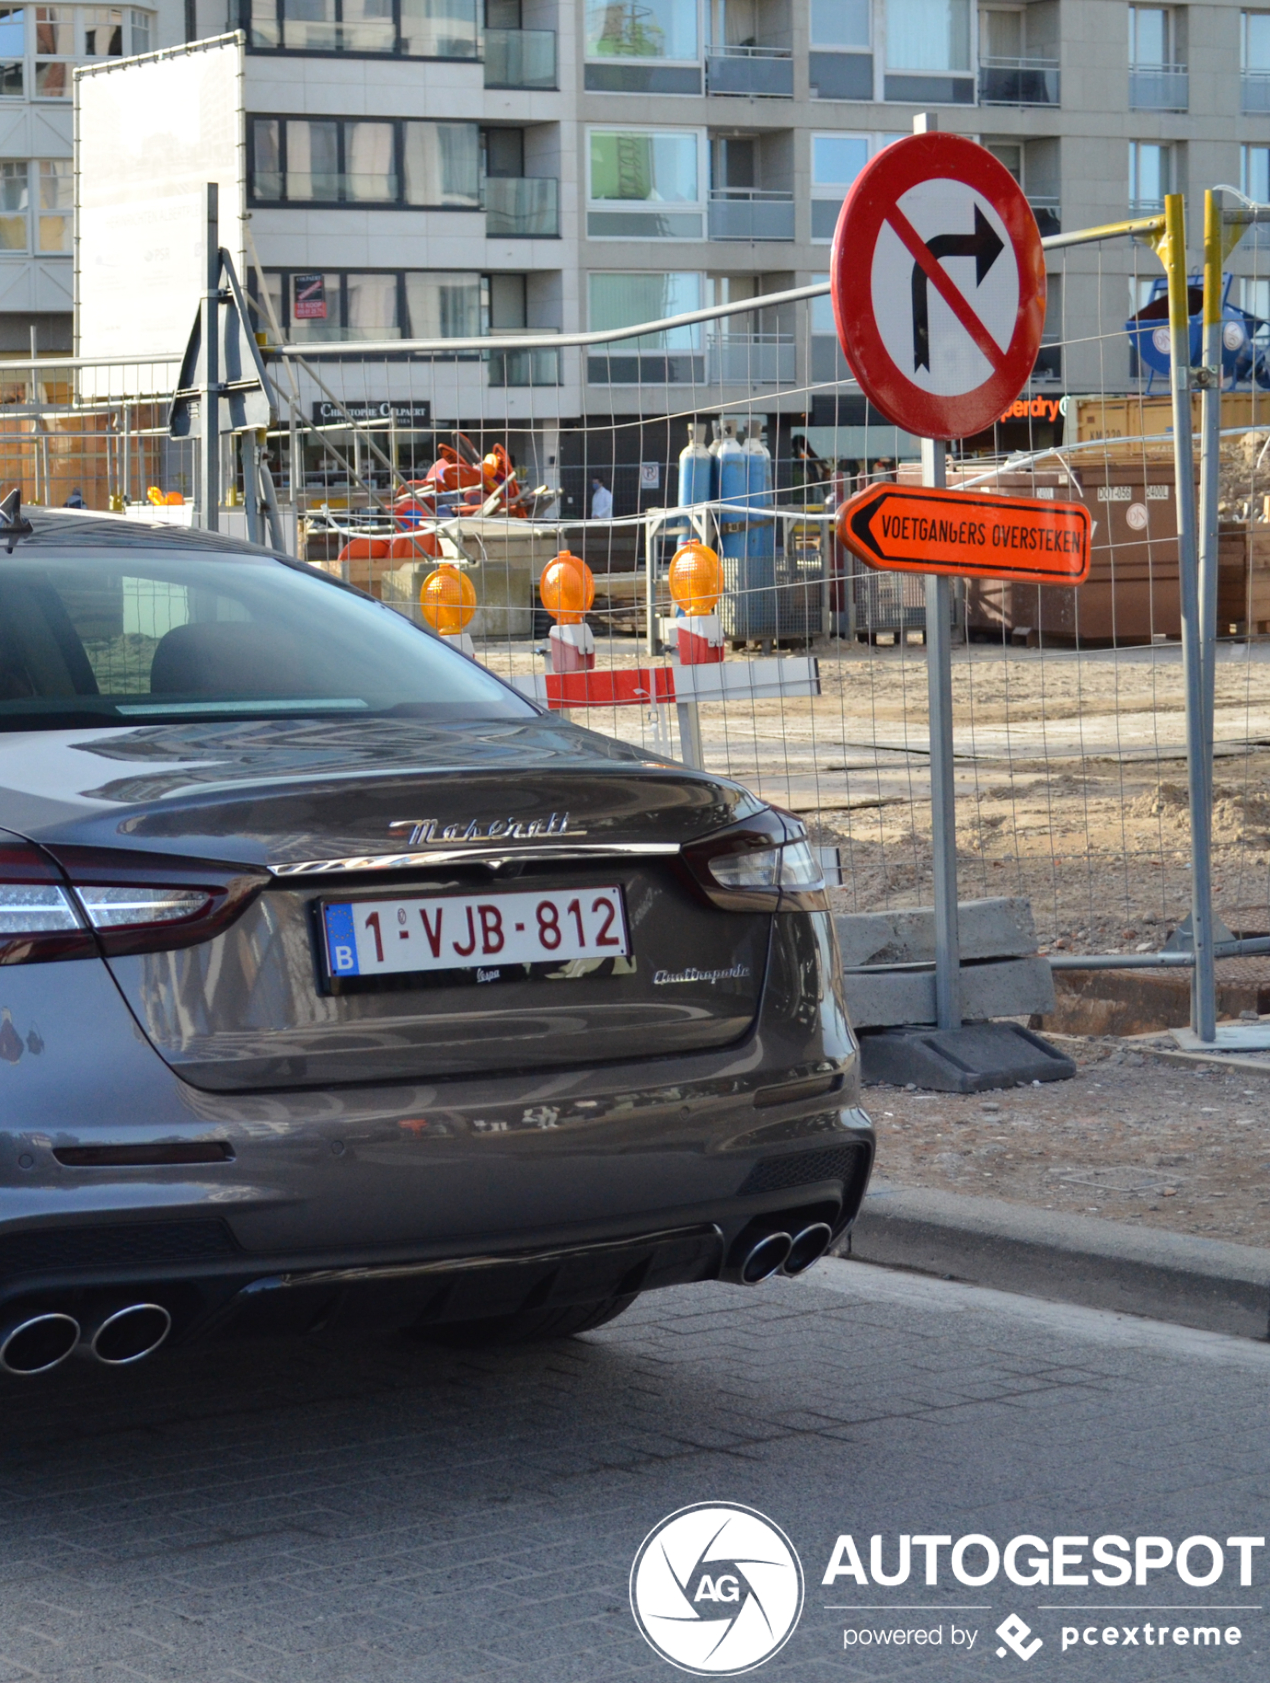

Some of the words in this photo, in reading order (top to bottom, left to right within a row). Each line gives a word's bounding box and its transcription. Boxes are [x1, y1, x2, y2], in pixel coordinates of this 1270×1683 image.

[881, 513, 986, 547] VOETGANGERS
[992, 524, 1081, 555] OVERSTEKEN
[389, 811, 588, 846] Maserati
[364, 896, 620, 962] 1-VJB-812
[336, 945, 354, 971] B
[653, 964, 750, 985] Quattroporte
